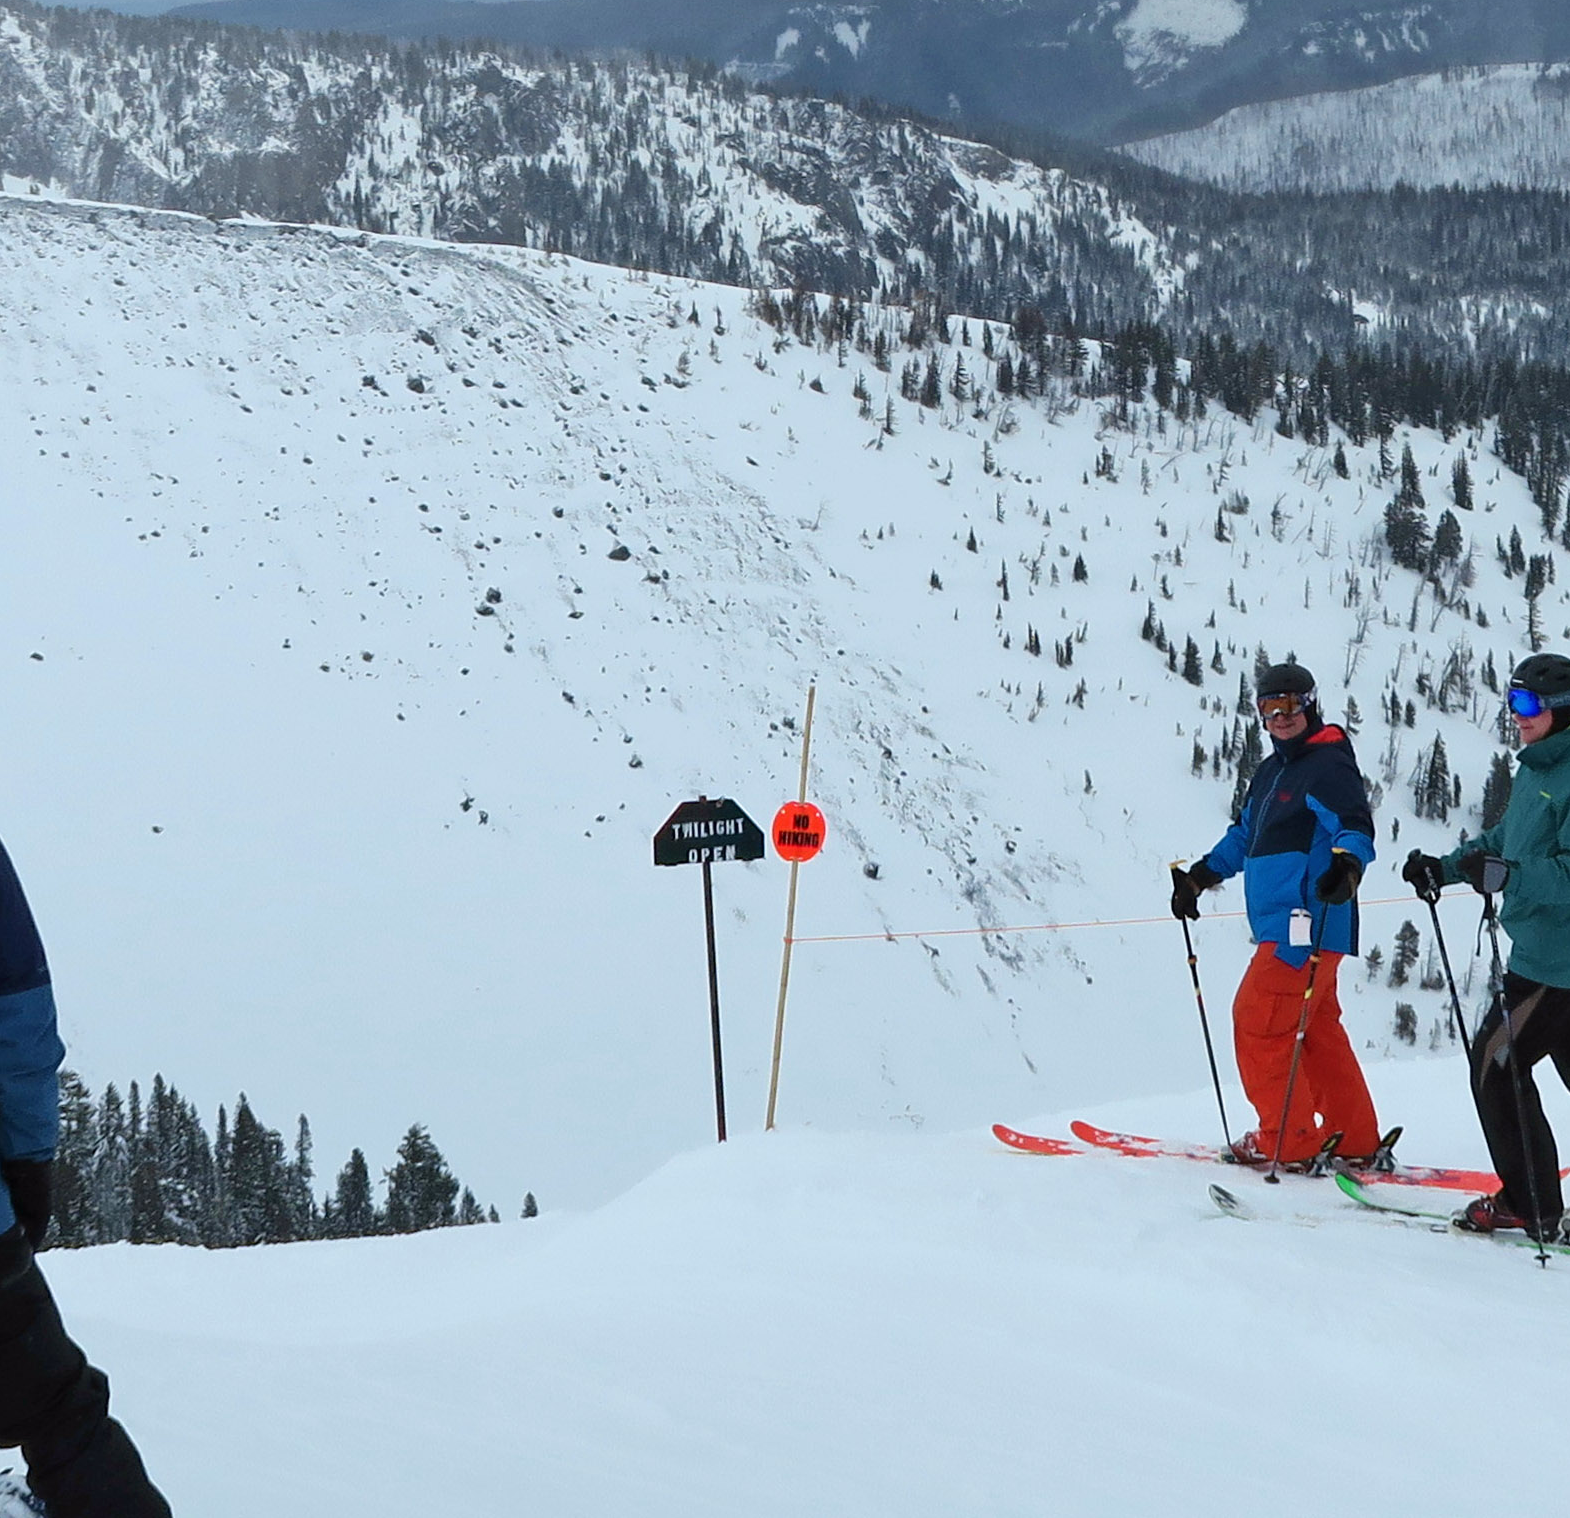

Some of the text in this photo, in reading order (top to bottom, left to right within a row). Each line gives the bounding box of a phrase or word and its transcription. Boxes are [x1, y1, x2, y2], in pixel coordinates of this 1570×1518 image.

[672, 818, 744, 840] TWILIGHT
[793, 814, 810, 830] NO
[778, 830, 819, 848] HIKING
[688, 845, 736, 863] OPEN
